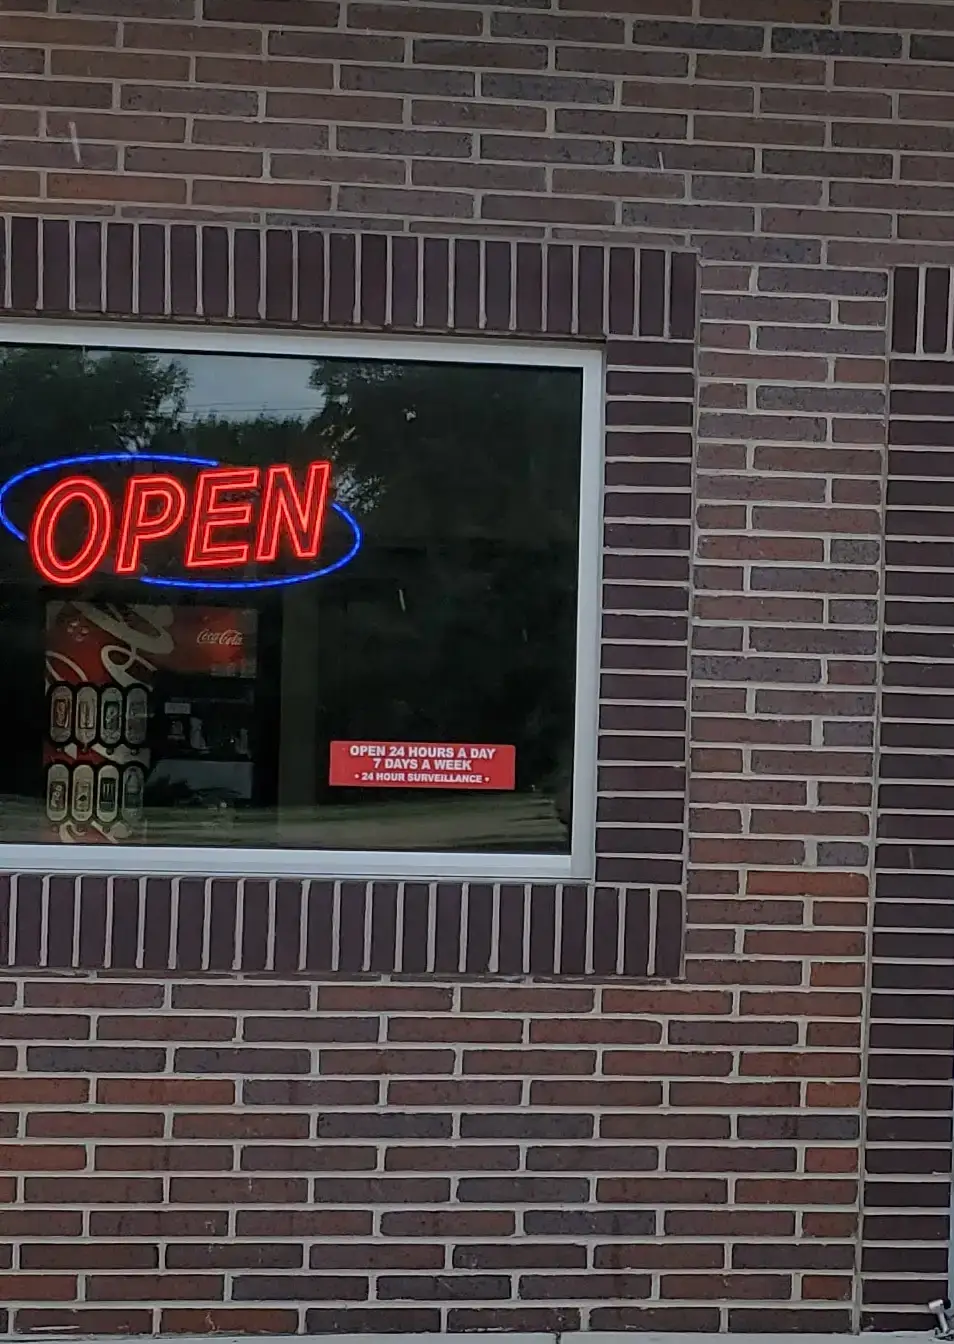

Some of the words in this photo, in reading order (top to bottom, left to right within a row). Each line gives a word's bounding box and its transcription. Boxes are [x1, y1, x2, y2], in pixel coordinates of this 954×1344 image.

[30, 460, 333, 584] OPEN
[350, 745, 386, 757] OPEN
[389, 747, 405, 757] 24
[408, 747, 454, 758] HOURS
[457, 748, 467, 758] A
[470, 748, 496, 759] DAY
[373, 758, 380, 769] 7
[385, 758, 418, 770] DAYS
[421, 759, 430, 770] A
[434, 759, 472, 771] WEEK
[361, 772, 374, 781] 24
[376, 772, 405, 782] HOUR
[407, 773, 483, 784] SURVEILLANCE
